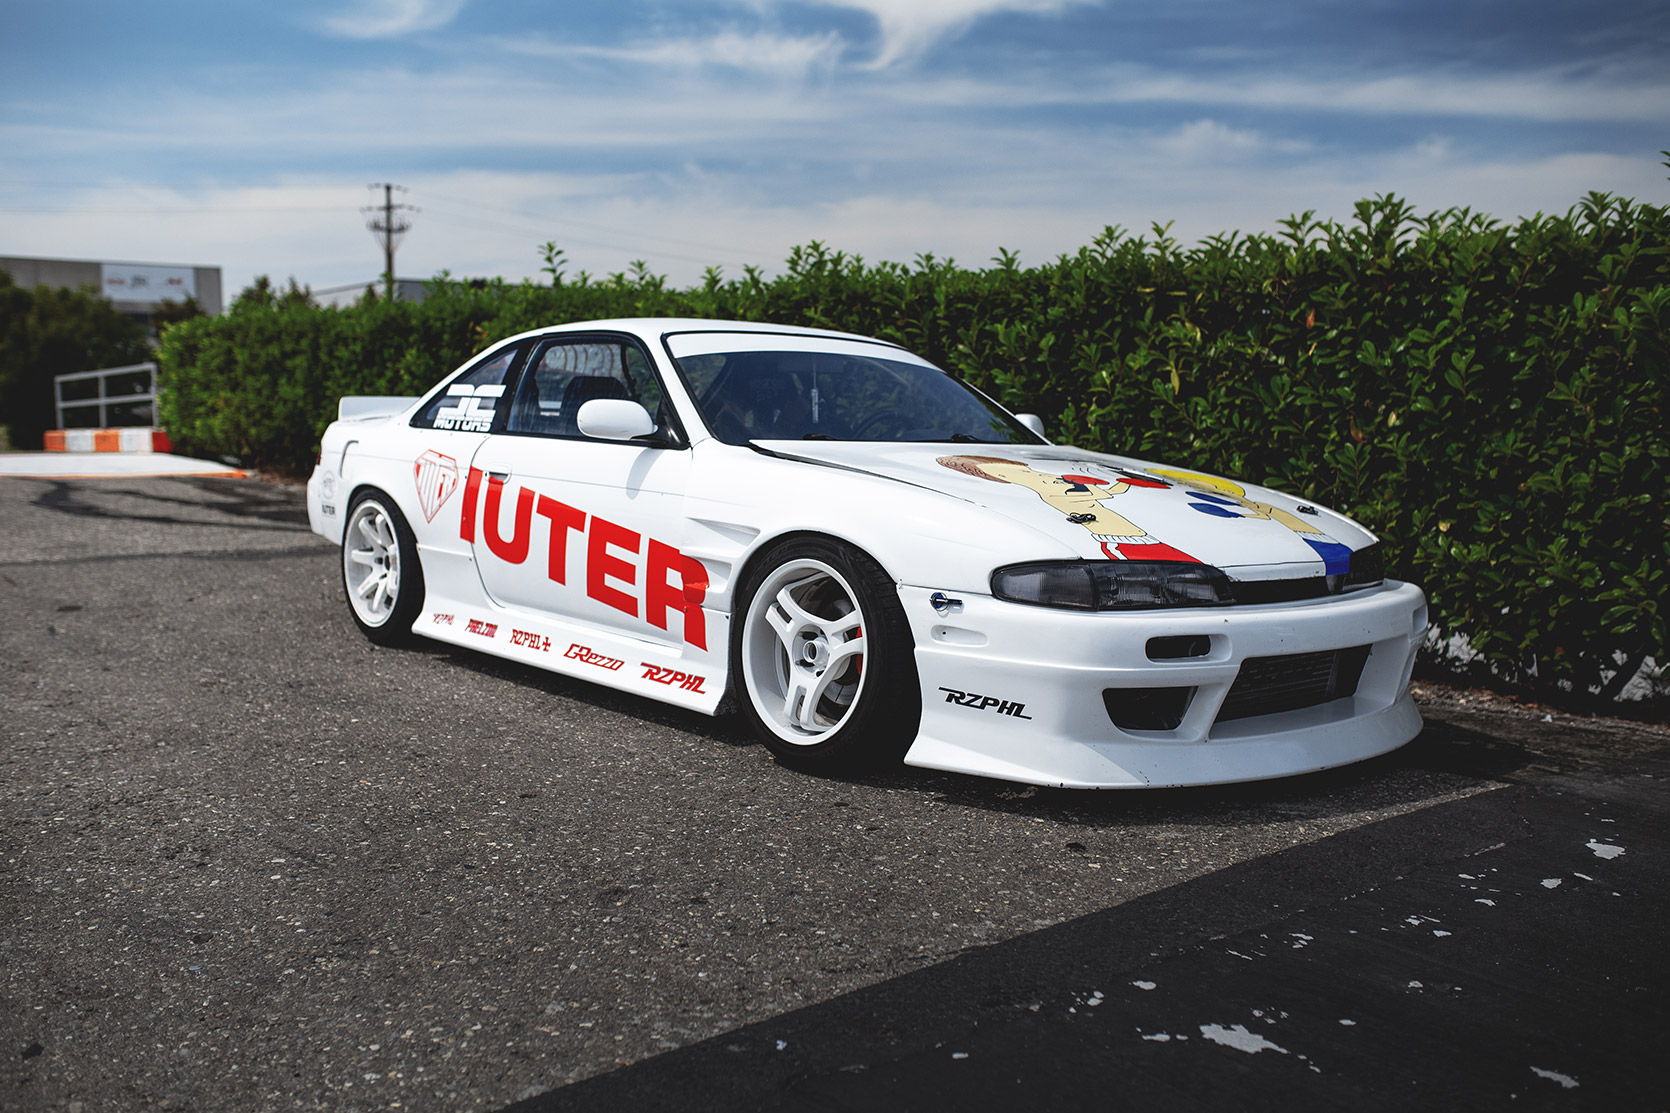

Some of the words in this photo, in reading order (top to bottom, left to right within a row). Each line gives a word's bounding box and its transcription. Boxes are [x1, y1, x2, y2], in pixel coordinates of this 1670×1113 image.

[432, 414, 493, 432] MOTORS
[460, 466, 710, 652] IUTER
[640, 662, 707, 694] RZPHL
[938, 686, 1033, 720] RZPHL
